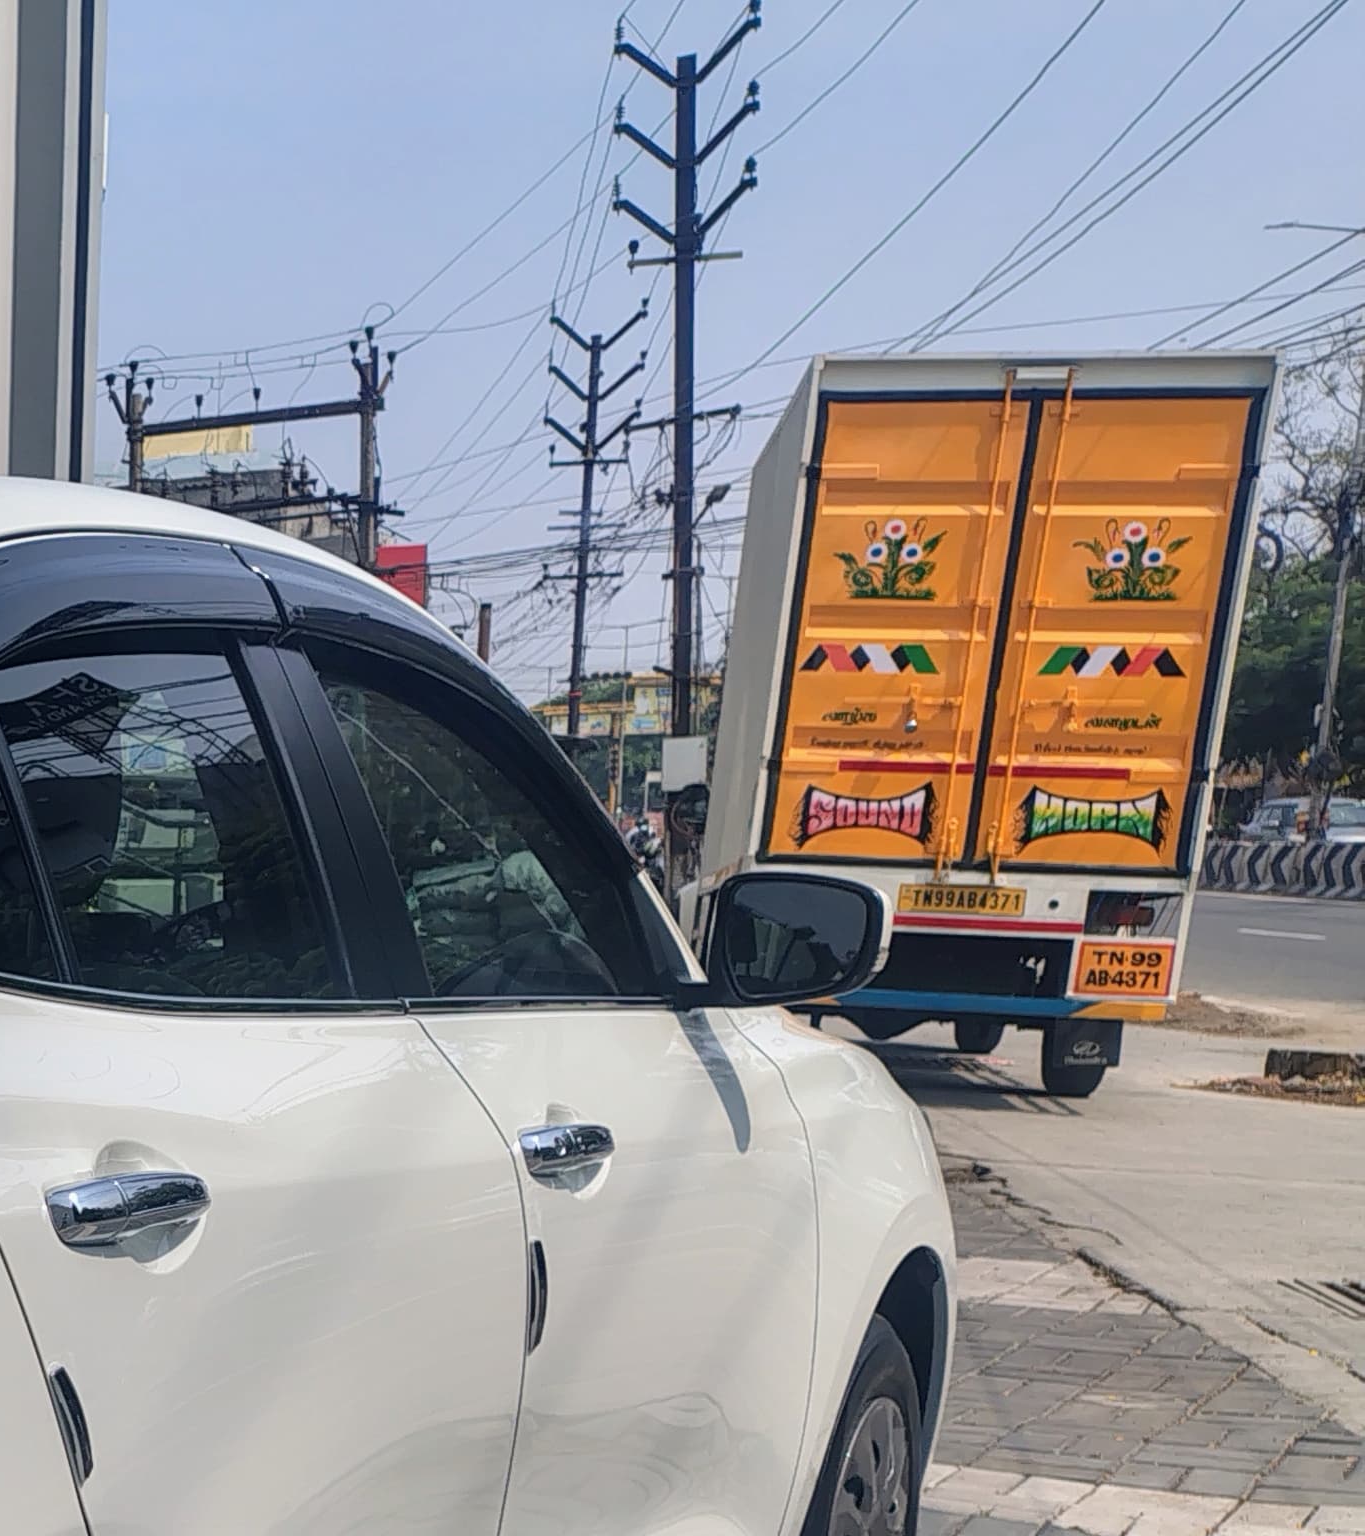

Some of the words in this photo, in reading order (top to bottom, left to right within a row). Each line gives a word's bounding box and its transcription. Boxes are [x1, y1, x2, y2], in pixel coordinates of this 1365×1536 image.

[807, 787, 927, 837] SOUND
[1029, 788, 1158, 842] HORN
[912, 888, 1022, 911] TN99AB4371
